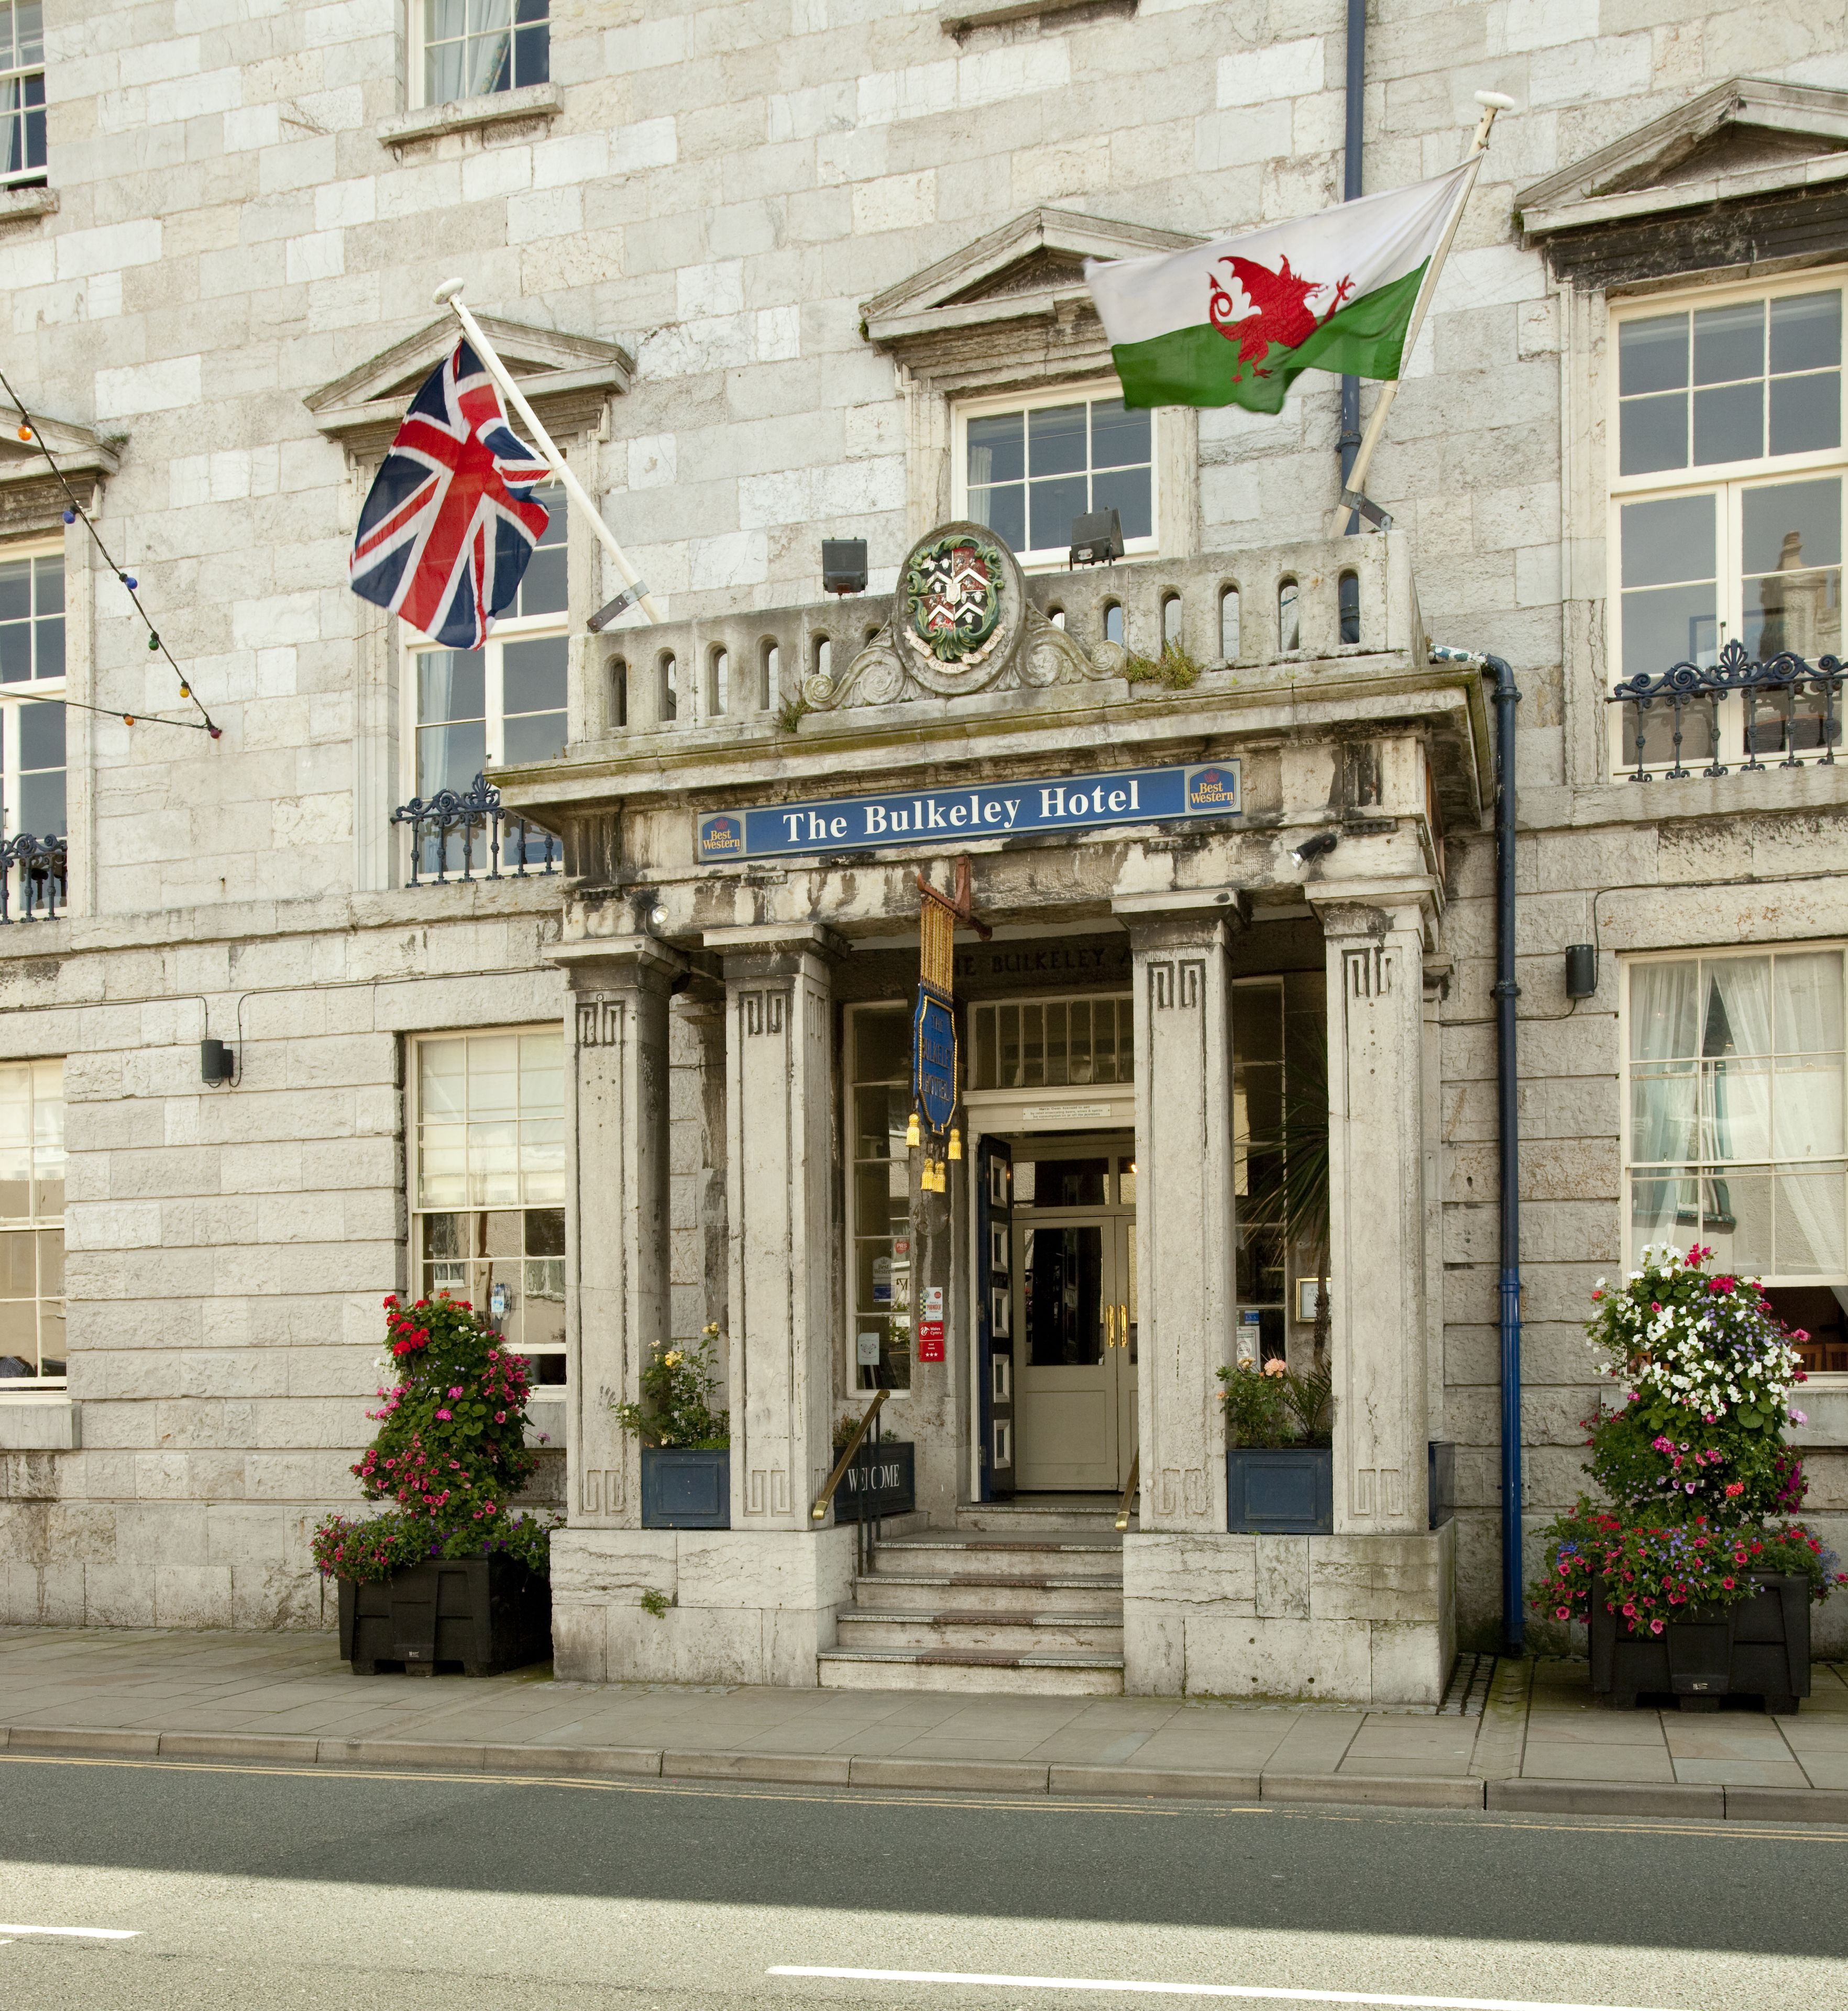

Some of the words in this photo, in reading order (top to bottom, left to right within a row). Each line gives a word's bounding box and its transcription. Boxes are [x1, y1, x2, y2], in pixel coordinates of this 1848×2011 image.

[916, 640, 928, 652] NEC
[930, 659, 961, 671] TEMERE
[1199, 781, 1223, 793] Best
[1191, 790, 1234, 804] Western
[783, 811, 847, 842] The
[863, 795, 1021, 835] Bulkeley
[1038, 780, 1140, 818] Hotel
[703, 837, 740, 850] Western
[710, 829, 731, 841] Best
[992, 947, 1105, 973] BULKELEY
[932, 1015, 943, 1033] THE
[923, 1072, 950, 1101] HOTEL
